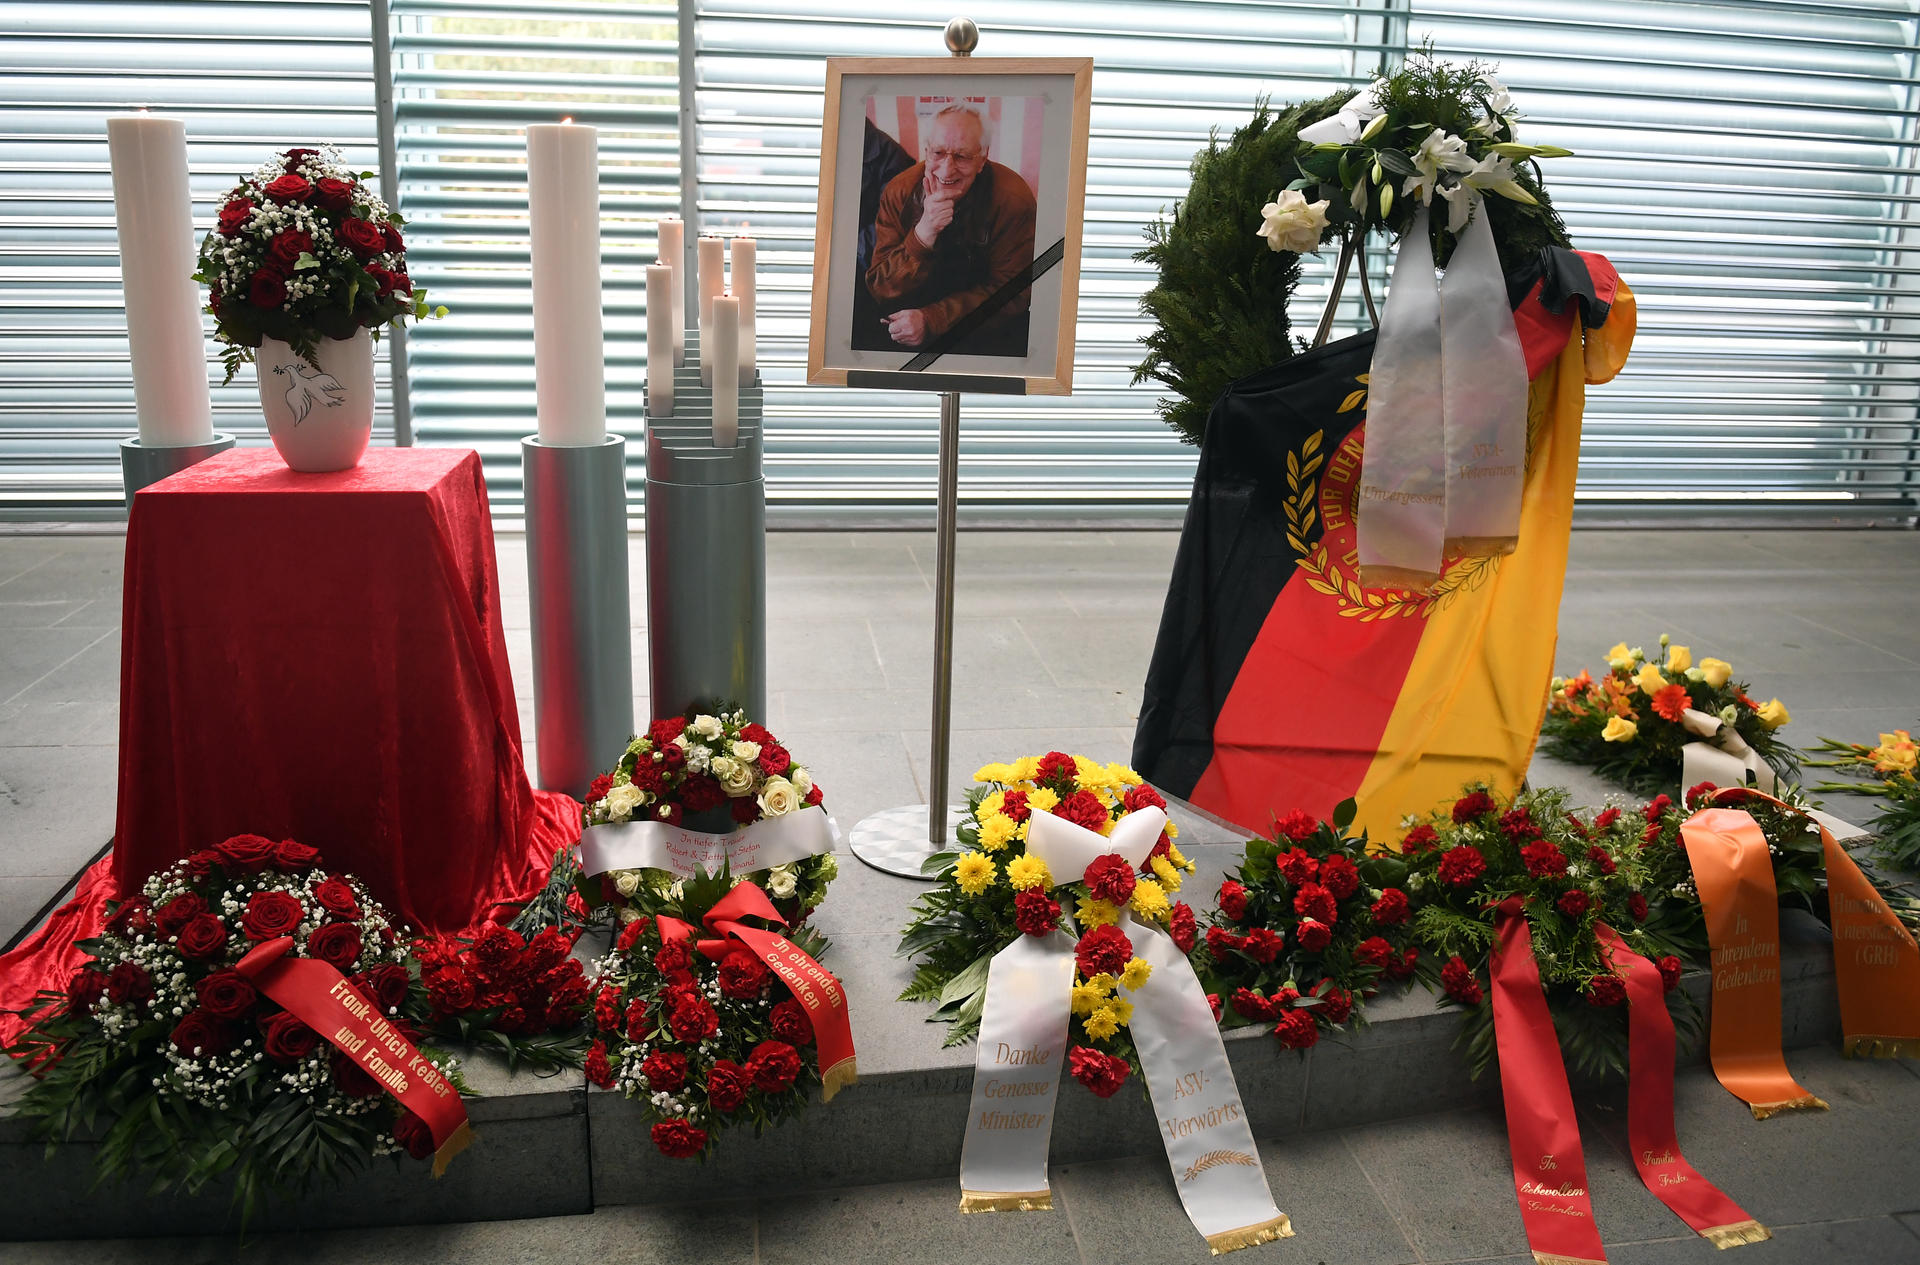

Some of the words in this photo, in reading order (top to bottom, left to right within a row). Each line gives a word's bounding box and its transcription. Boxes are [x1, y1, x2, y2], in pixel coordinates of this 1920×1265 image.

[1328, 438, 1365, 484] DEN
[1321, 488, 1346, 531] FÜR
[666, 841, 688, 857] Robert
[691, 850, 698, 859] &
[738, 843, 760, 856] Stefan
[1736, 911, 1748, 935] In
[767, 953, 821, 1010] Gedenken
[789, 953, 842, 1008] ehrendem
[1715, 964, 1777, 992] Gedenken
[329, 979, 408, 1060] Frank-Ulrich
[334, 1026, 367, 1054] und
[361, 1047, 409, 1094] Familie
[995, 1042, 1051, 1065] Danke
[984, 1080, 1049, 1098] Genosse
[1174, 1070, 1210, 1100] ASV-
[977, 1110, 1047, 1131] Minister
[1166, 1103, 1239, 1140] Vorwärts
[1520, 1182, 1585, 1197] liebevollem
[1527, 1201, 1585, 1217] Gedenken
